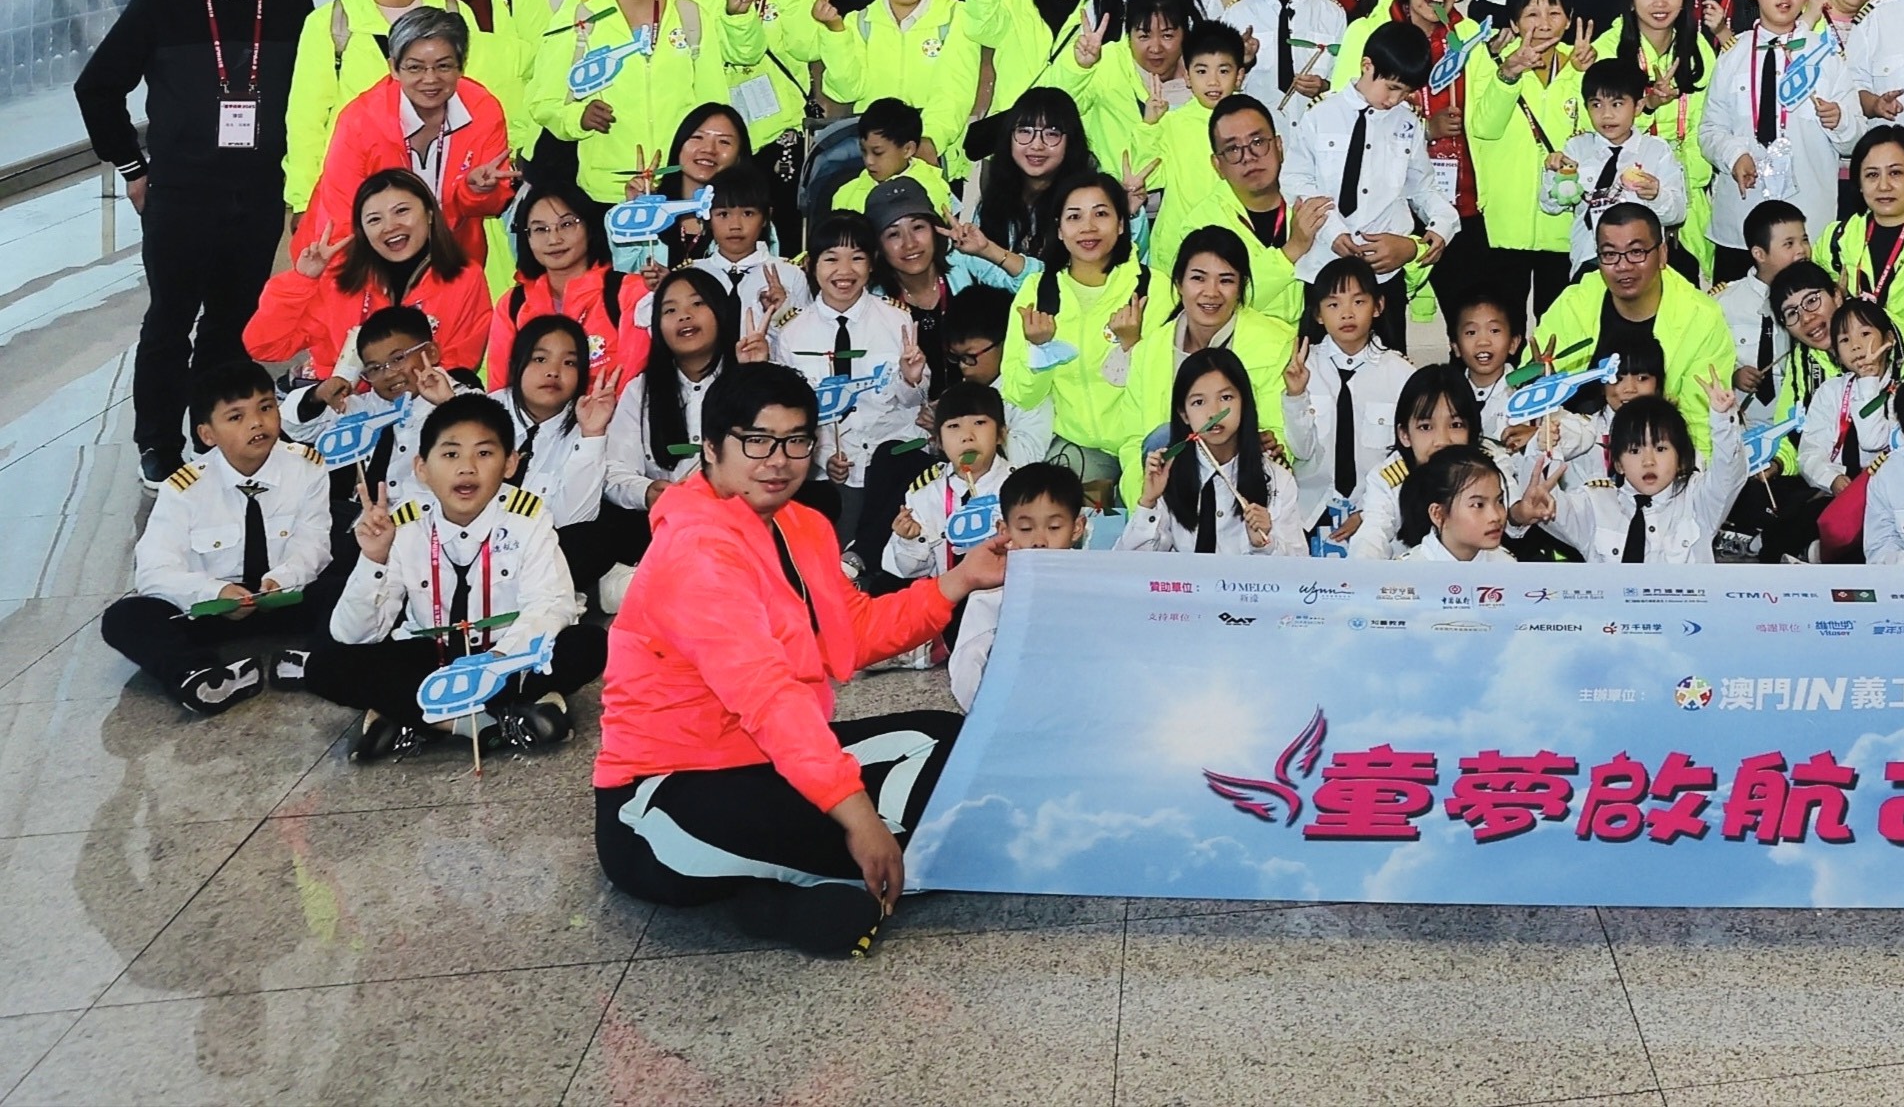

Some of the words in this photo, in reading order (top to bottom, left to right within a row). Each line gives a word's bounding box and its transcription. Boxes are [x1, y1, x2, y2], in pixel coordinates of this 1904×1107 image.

[1238, 583, 1280, 593] MELCO
[1620, 623, 1662, 631] 万千研学
